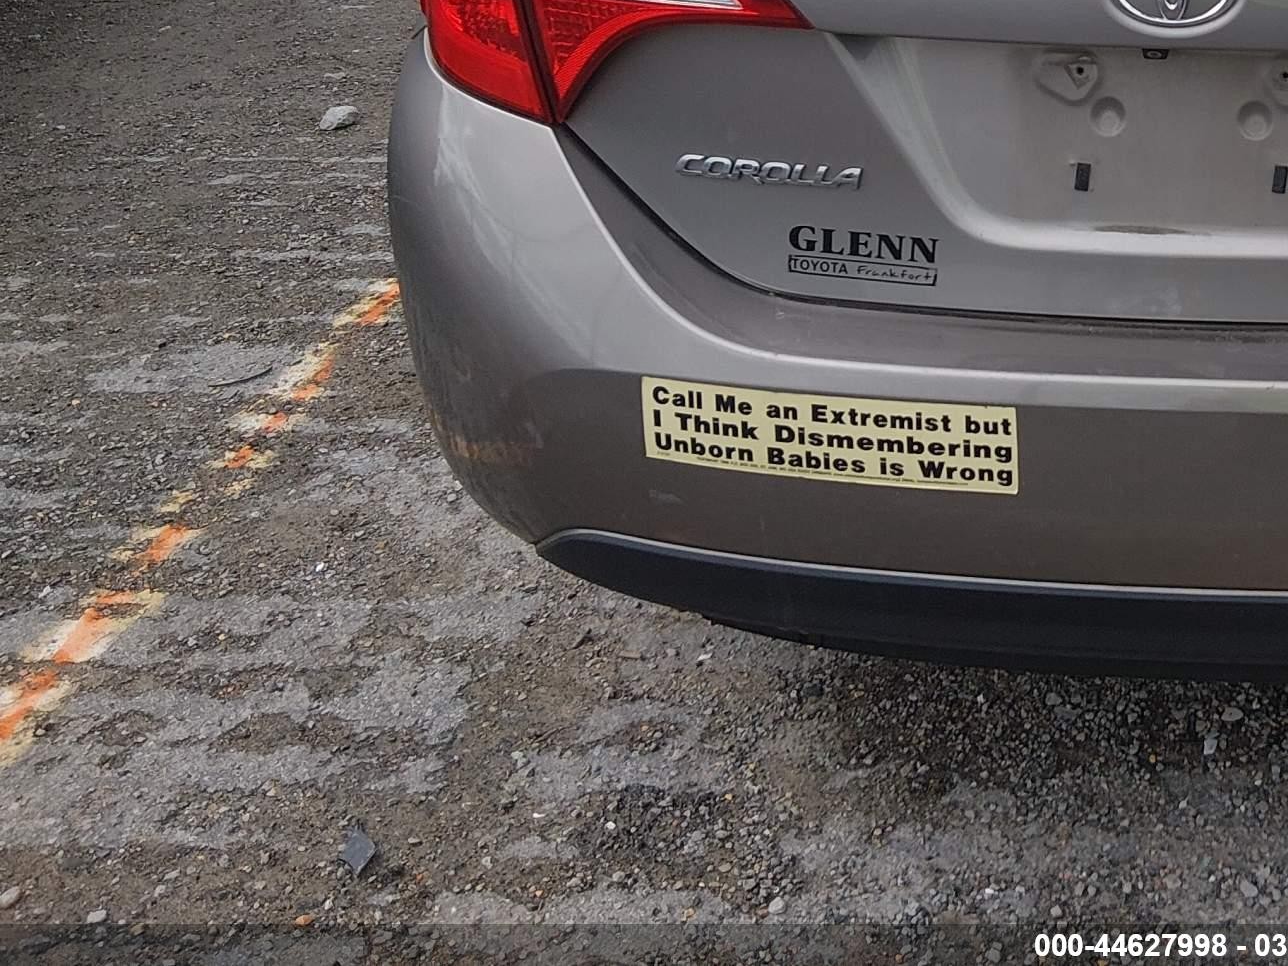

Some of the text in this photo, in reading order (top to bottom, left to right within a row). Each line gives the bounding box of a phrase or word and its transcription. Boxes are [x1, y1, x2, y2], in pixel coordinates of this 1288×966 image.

[675, 154, 863, 189] COROLLA
[788, 225, 939, 263] GLENN
[792, 257, 933, 282] TOYOTA Frankfort
[652, 386, 1012, 435] Call Me an Extremist but
[654, 410, 662, 427] I
[674, 413, 759, 440] Think
[775, 424, 1012, 463] Dismembering
[655, 432, 754, 461] Unborn
[767, 447, 866, 474] Babies
[880, 458, 905, 476] is
[918, 461, 1013, 486] Wrong
